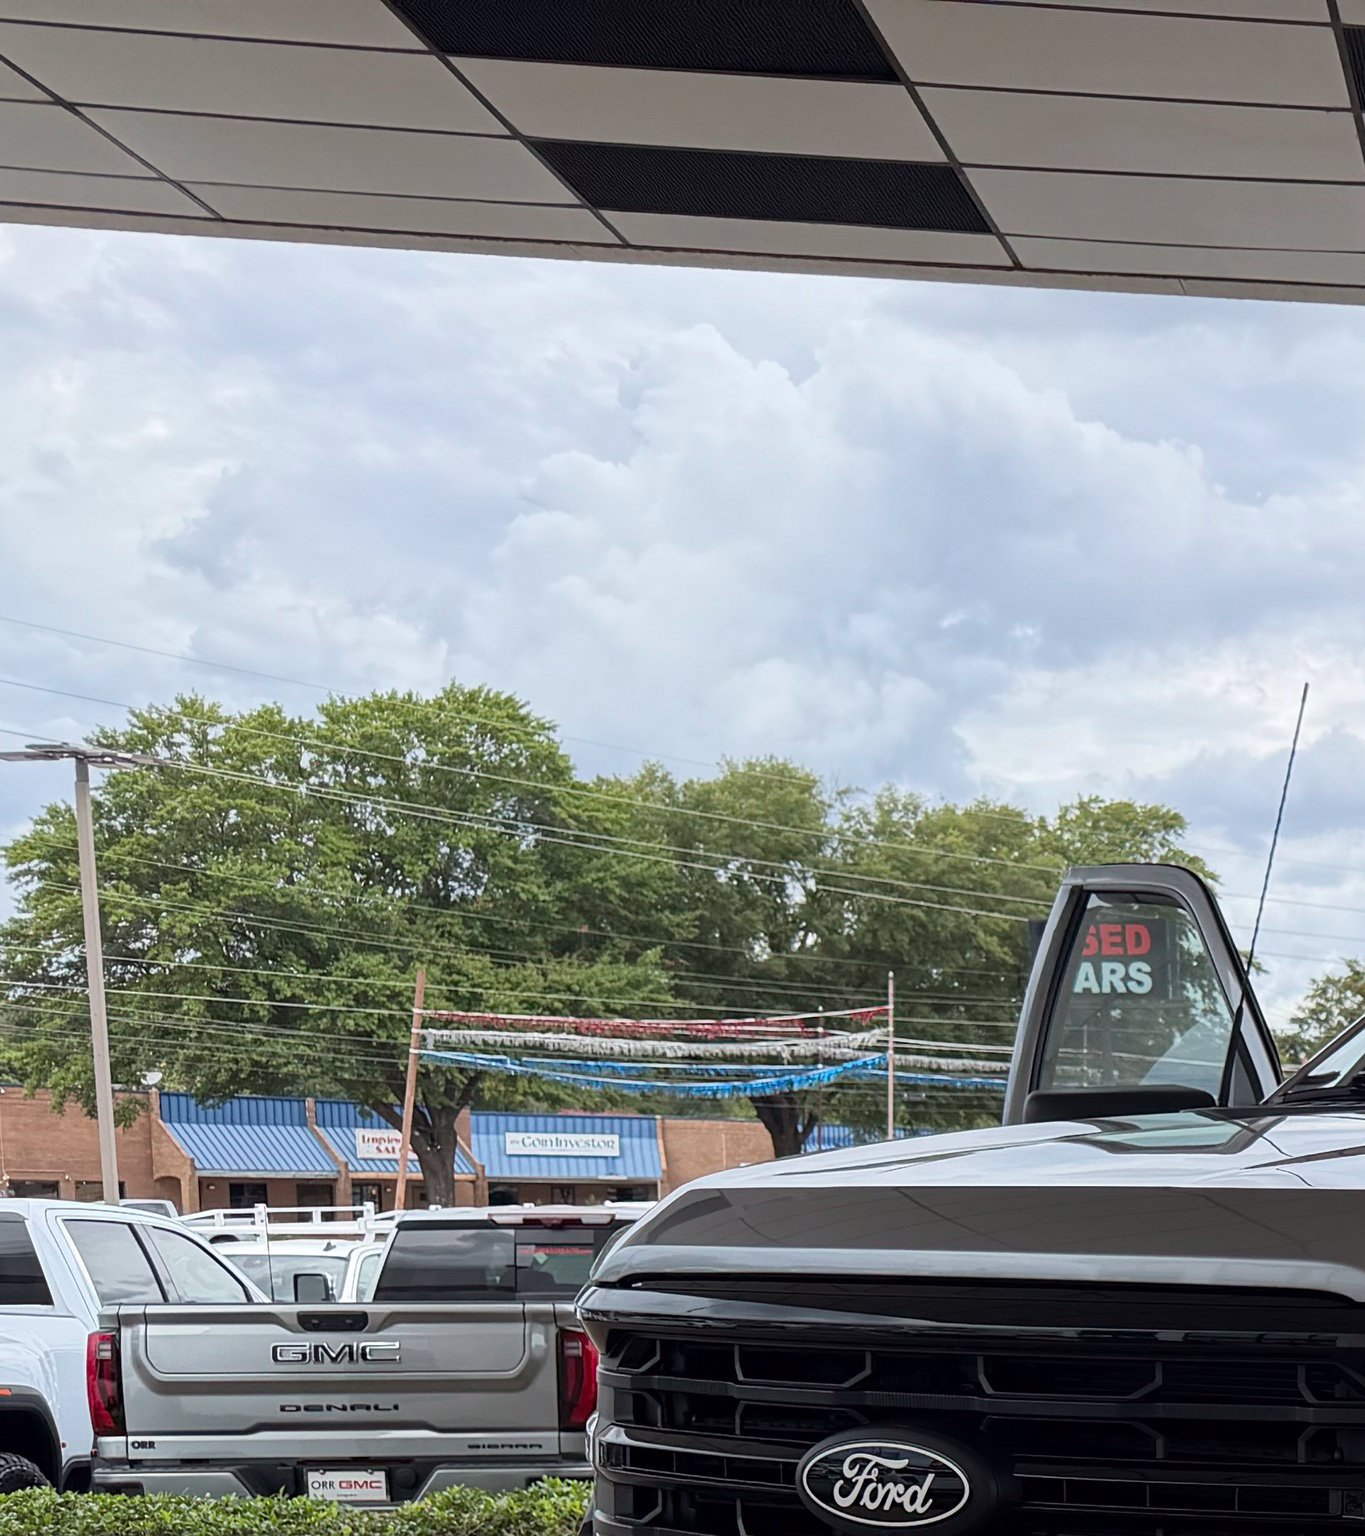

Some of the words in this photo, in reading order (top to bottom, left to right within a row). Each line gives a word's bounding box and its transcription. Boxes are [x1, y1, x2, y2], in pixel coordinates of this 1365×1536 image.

[1073, 961, 1153, 994] ARS
[271, 1341, 401, 1364] GMC
[279, 1403, 399, 1413] DENALI
[131, 1440, 156, 1450] ORR
[311, 1480, 335, 1490] ORR
[338, 1480, 383, 1490] GMC
[833, 1452, 936, 1515] Ford
